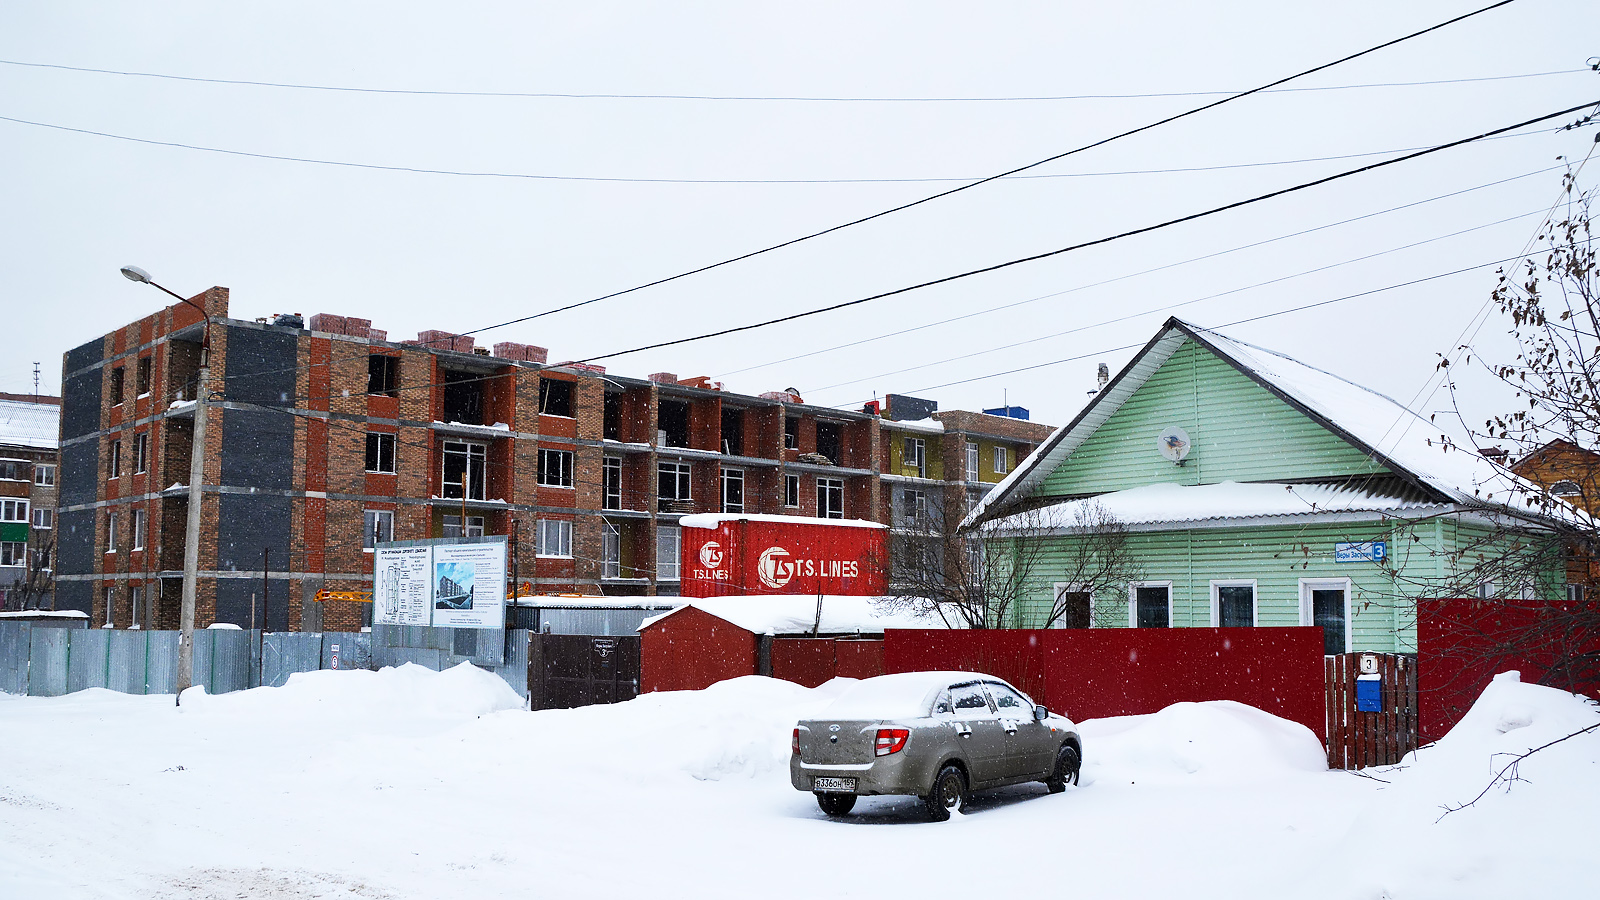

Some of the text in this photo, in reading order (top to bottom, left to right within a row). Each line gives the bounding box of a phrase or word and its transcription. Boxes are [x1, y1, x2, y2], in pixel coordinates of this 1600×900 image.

[1375, 545, 1384, 558] 3
[795, 559, 859, 578] T.S. LINES
[705, 569, 729, 581] LNES
[1366, 659, 1372, 670] 3
[816, 779, 841, 788] В336ОН
